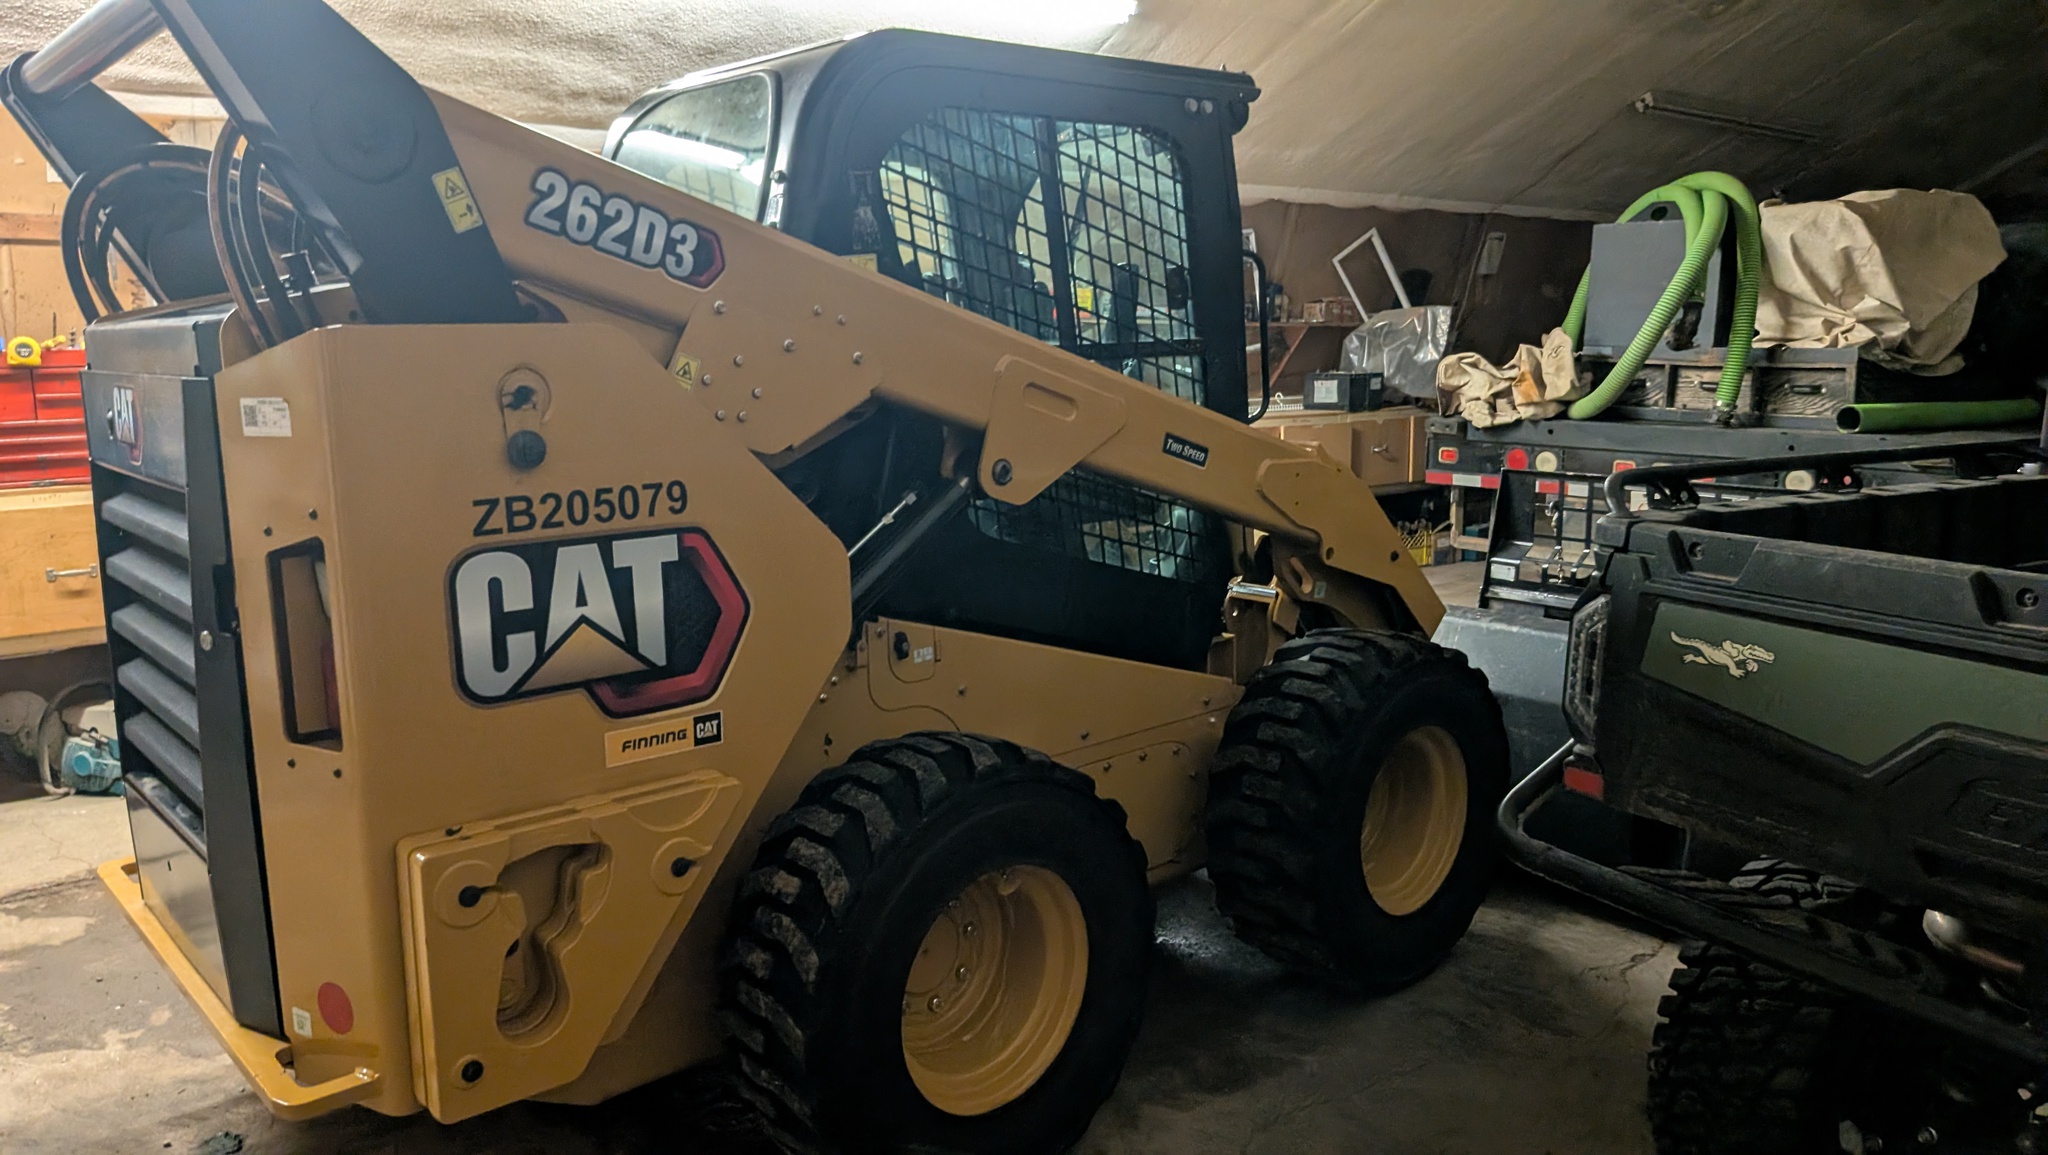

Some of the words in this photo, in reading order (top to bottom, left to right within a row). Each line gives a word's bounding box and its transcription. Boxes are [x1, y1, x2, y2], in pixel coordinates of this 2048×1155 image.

[527, 171, 699, 278] 262D3
[112, 386, 136, 443] CAT
[472, 480, 689, 537] ZB205079
[455, 533, 680, 698] CAT
[621, 728, 688, 753] FINNING
[696, 719, 719, 739] CAT
